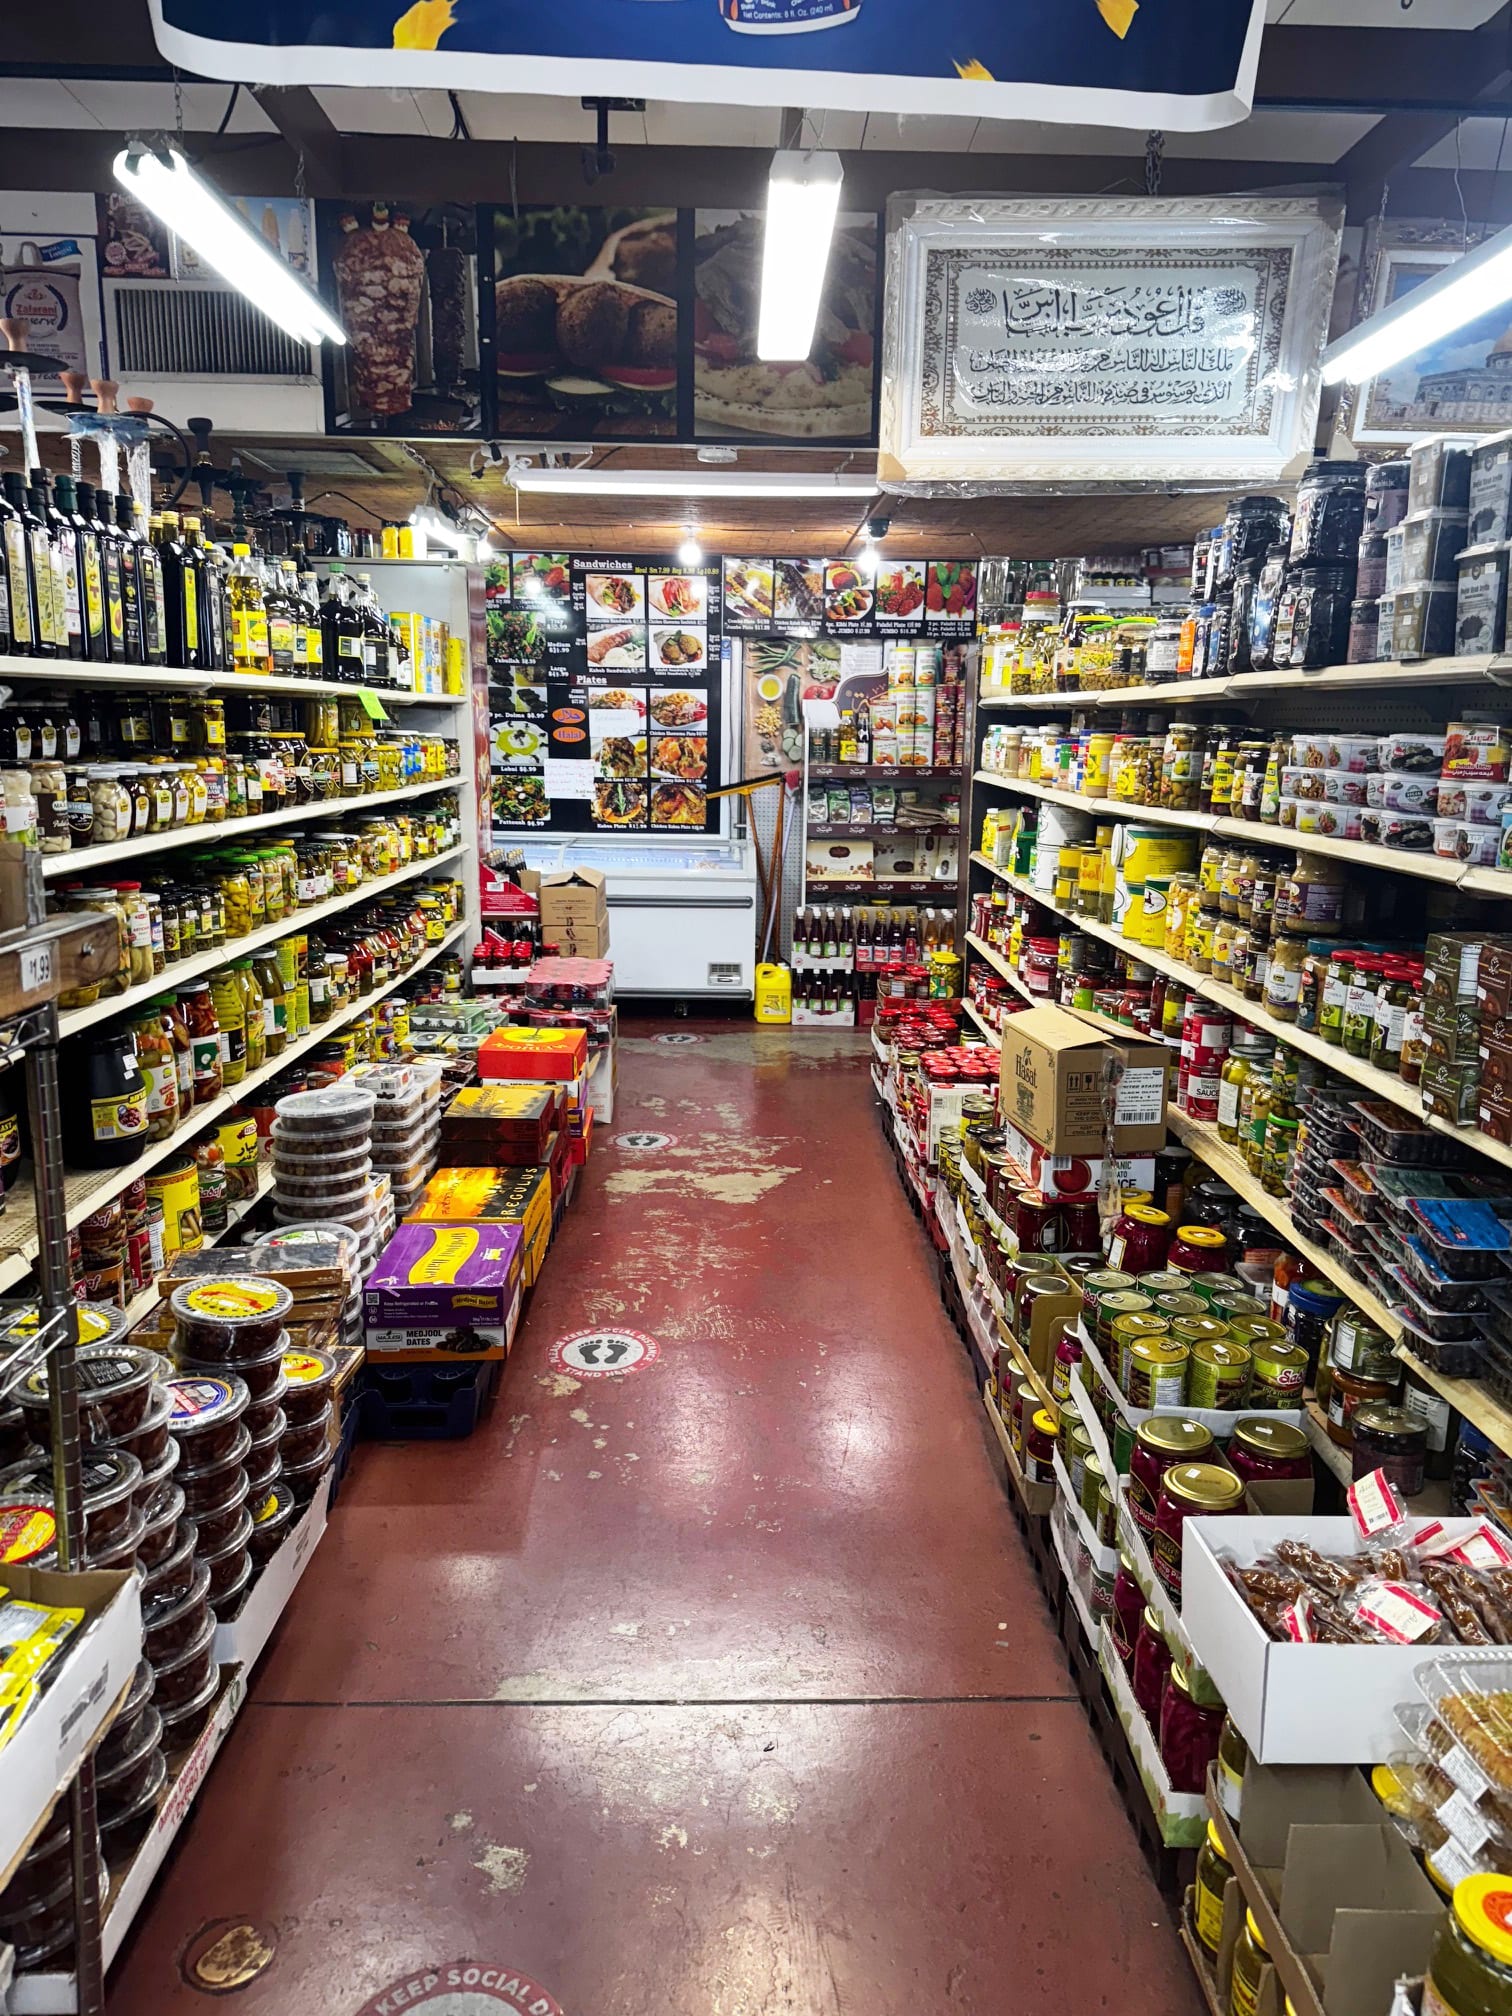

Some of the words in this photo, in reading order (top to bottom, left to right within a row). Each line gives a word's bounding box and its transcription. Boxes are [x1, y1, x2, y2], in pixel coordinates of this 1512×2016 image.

[754, 10, 783, 19] Contents:
[810, 6, 824, 15] (240
[16, 304, 57, 315] Zafarani
[573, 559, 633, 570] Sandwiches
[576, 675, 607, 685] Plates
[557, 731, 582, 740] Halal
[1196, 1088, 1219, 1098] SAUCE
[500, 1167, 538, 1216] REGULUS
[406, 1330, 443, 1338] MEDJOOL
[406, 1338, 431, 1346] DATES
[563, 1366, 602, 1378] STAND
[375, 1974, 439, 2016] KEEP
[447, 1967, 531, 2003] SOCIAL
